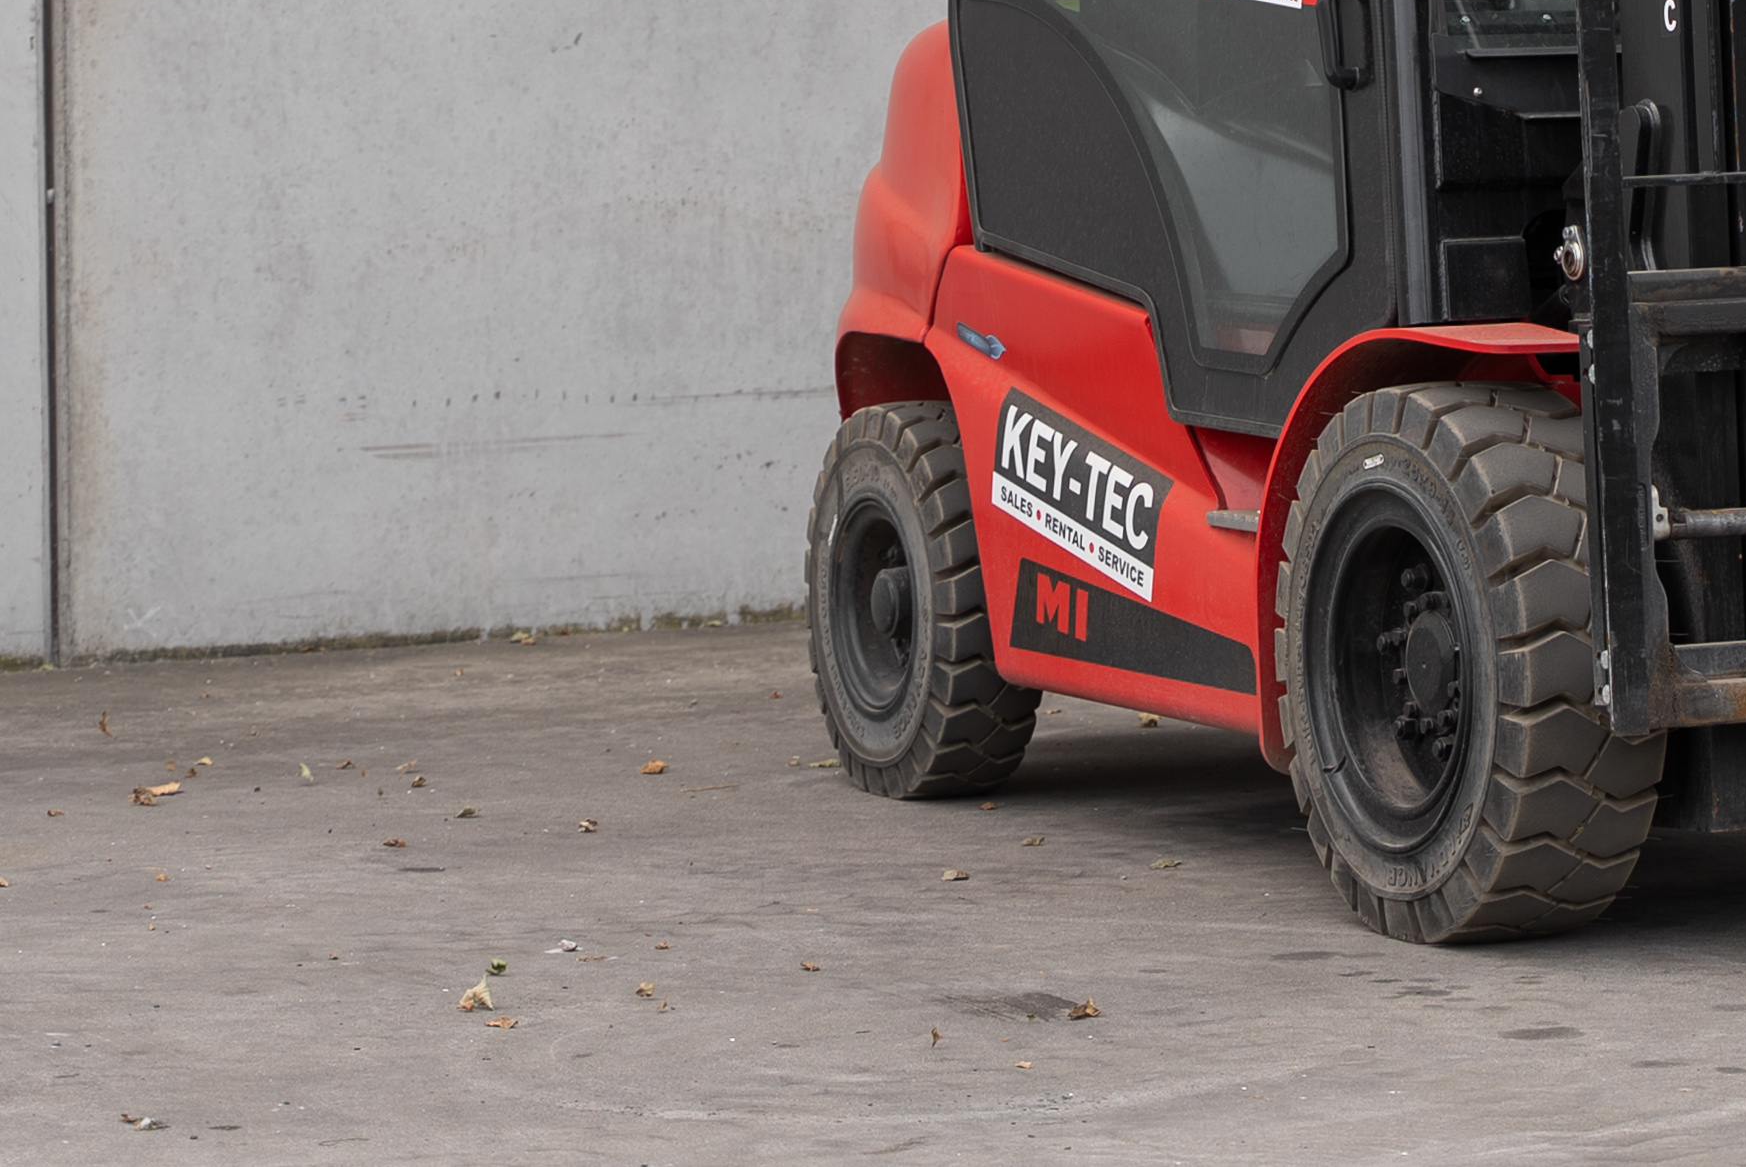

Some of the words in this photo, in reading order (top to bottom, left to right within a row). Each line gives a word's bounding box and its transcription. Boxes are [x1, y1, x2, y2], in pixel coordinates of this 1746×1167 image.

[1001, 405, 1154, 551] KEY-TEC
[1001, 485, 1033, 518] SALES
[1045, 513, 1086, 552] RENTAL
[1098, 546, 1144, 588] SERVICE
[1036, 572, 1088, 642] MI
